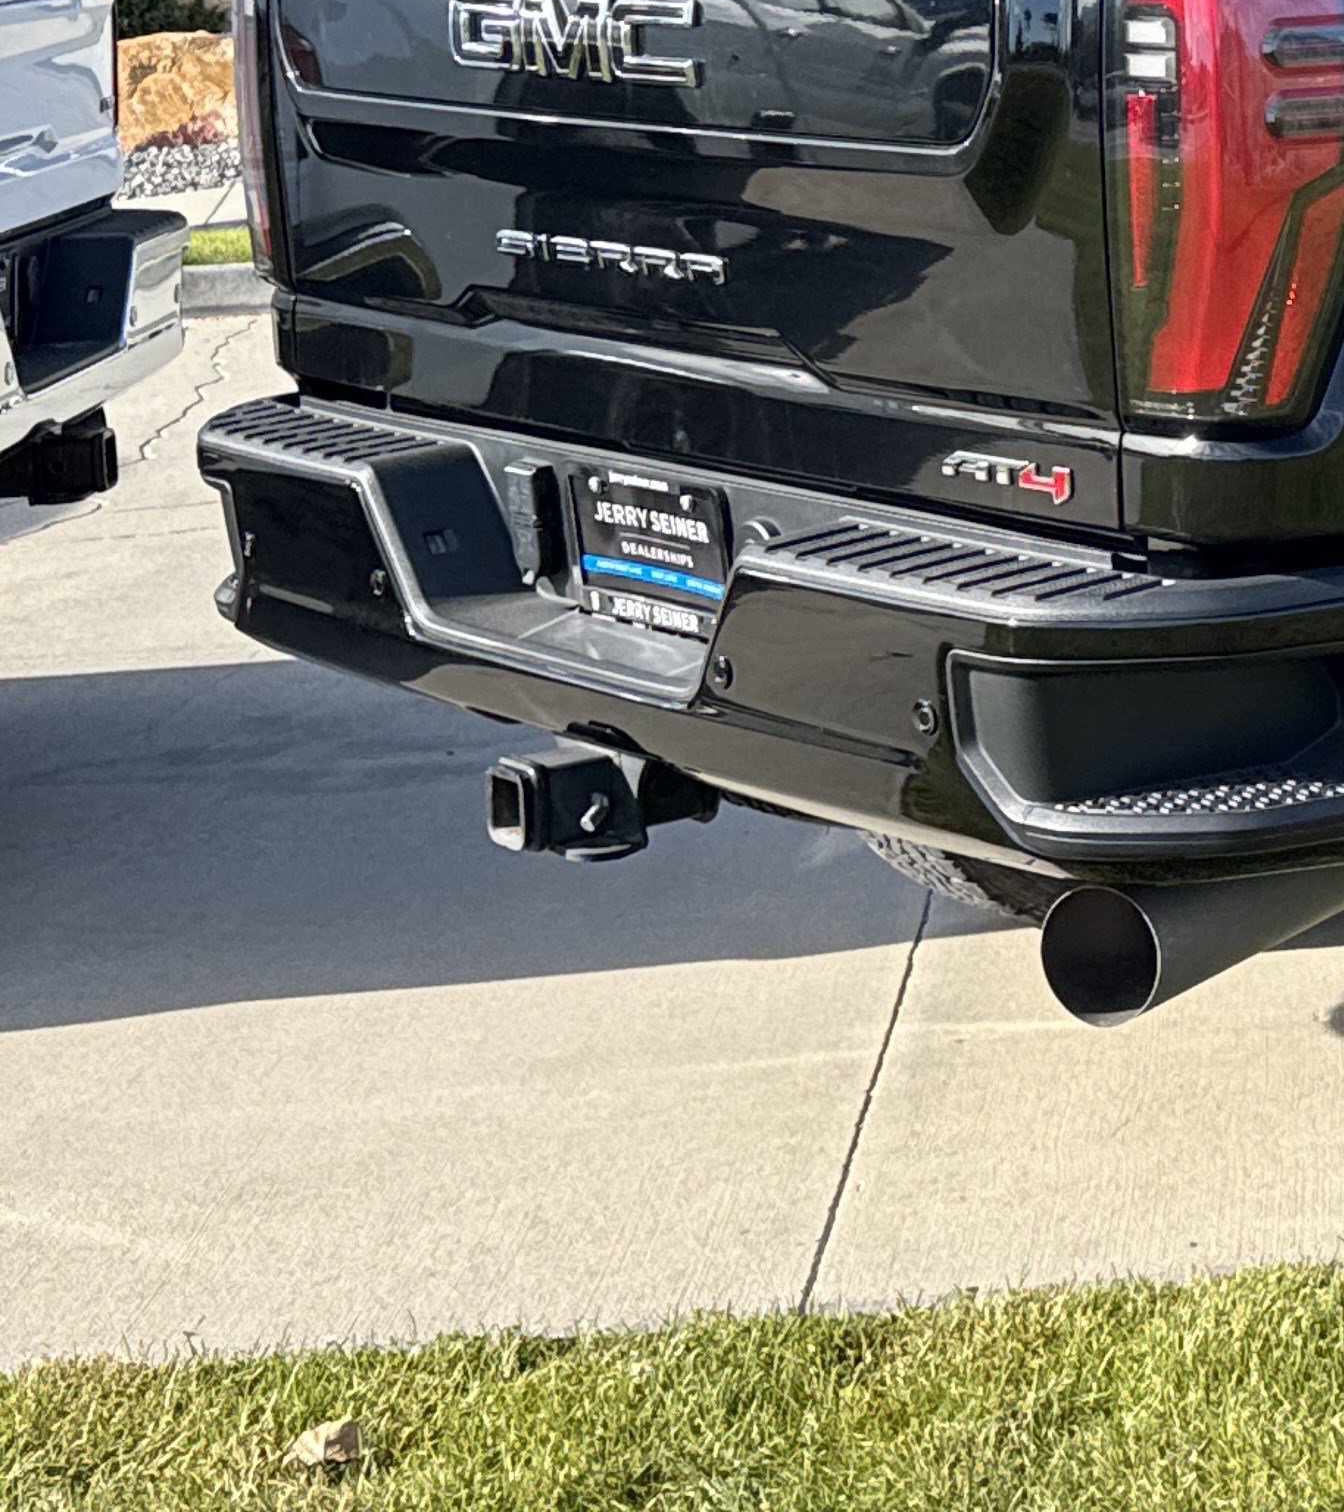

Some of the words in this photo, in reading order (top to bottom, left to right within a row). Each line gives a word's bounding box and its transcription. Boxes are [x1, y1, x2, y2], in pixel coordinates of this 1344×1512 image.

[495, 228, 728, 285] SIERRA
[942, 449, 1074, 506] AT4
[594, 500, 648, 529] JERRY
[650, 510, 710, 544] SEINER
[620, 541, 694, 569] DEALERSHIPS
[612, 597, 651, 624] JERRY
[652, 604, 700, 633] SEINER
